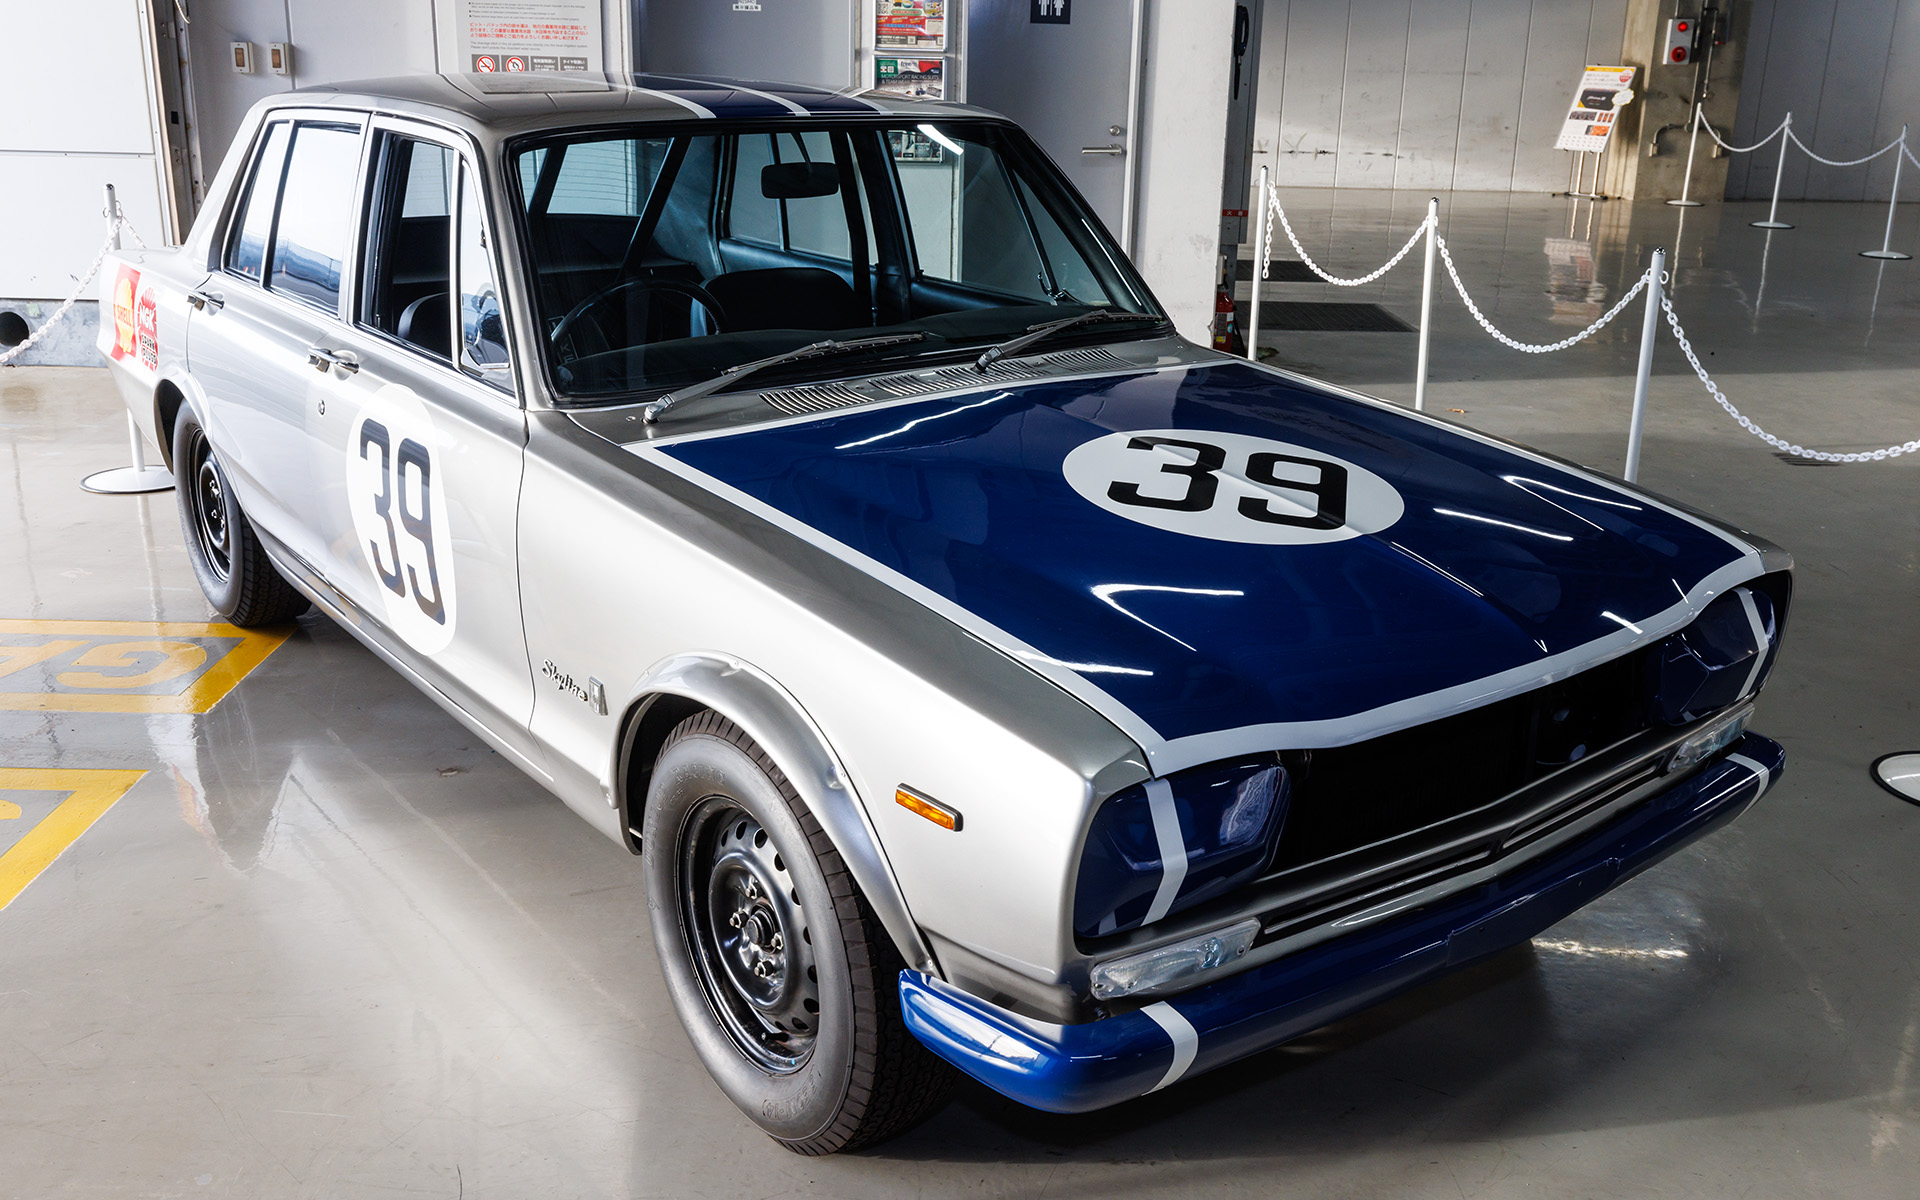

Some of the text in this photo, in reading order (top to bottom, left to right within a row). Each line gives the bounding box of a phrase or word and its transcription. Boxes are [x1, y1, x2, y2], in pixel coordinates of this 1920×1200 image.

[117, 305, 132, 327] SHELL
[139, 304, 155, 332] NGK
[1106, 435, 1349, 531] 39
[360, 417, 447, 626] 39
[541, 658, 589, 702] Skyline
